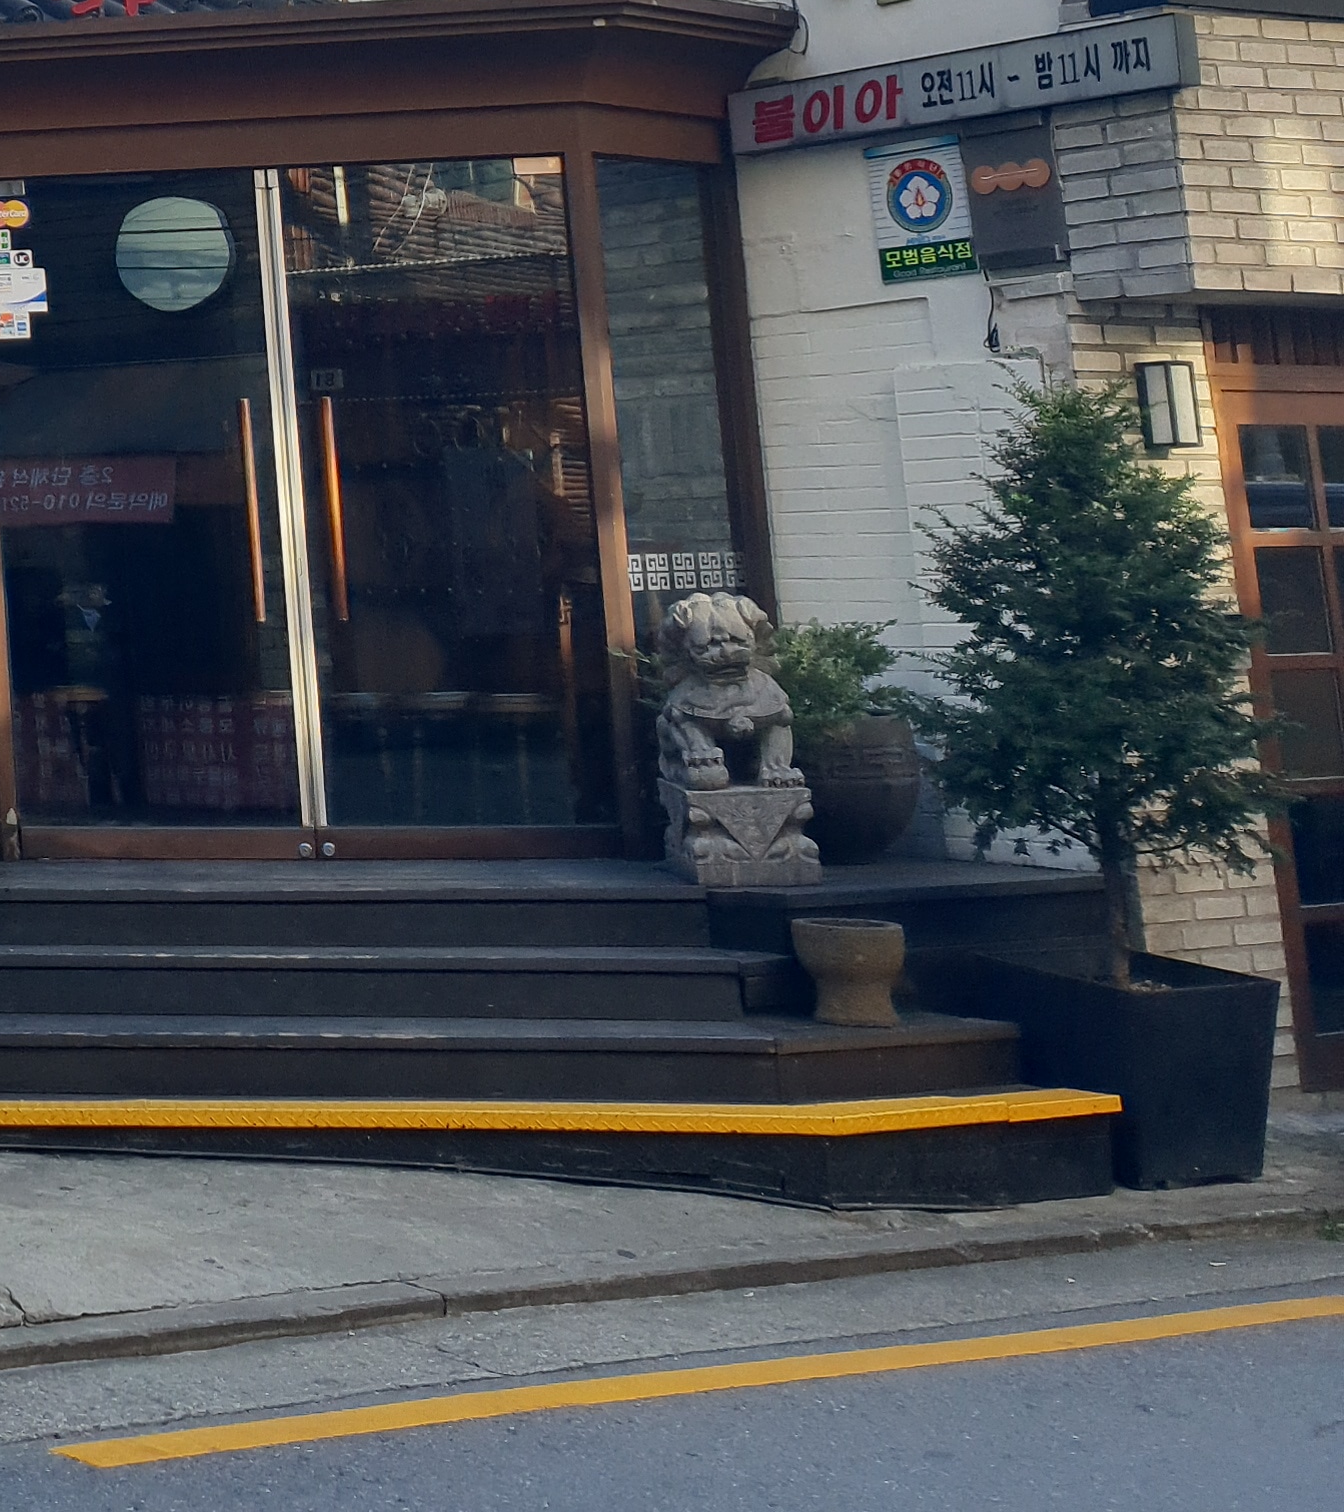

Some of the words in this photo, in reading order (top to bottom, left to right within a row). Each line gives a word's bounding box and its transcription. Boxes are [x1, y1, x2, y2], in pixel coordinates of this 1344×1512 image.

[753, 75, 904, 143] 불이아
[920, 61, 996, 108] 오전11시
[1035, 45, 1101, 90] 밤11시
[1112, 37, 1151, 72] 까지
[886, 241, 973, 268] 모범음식점
